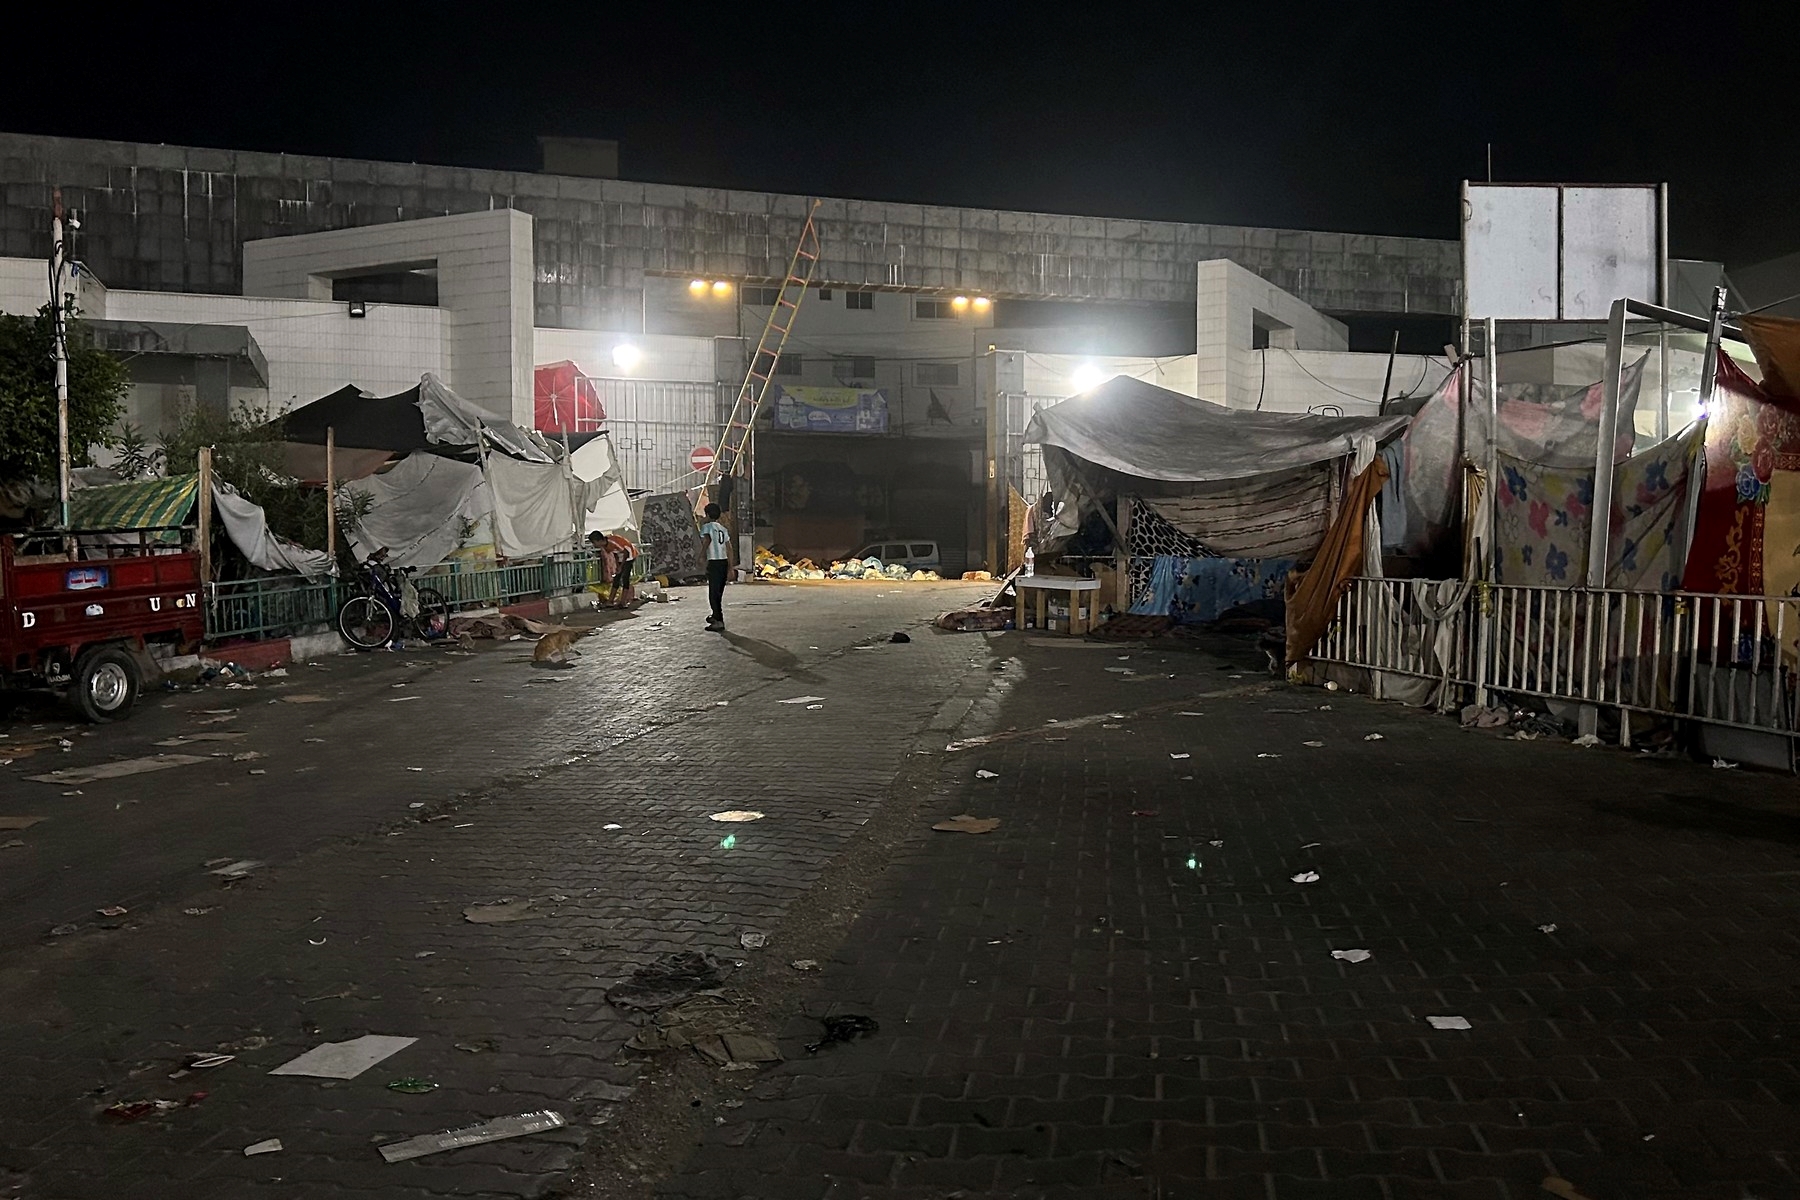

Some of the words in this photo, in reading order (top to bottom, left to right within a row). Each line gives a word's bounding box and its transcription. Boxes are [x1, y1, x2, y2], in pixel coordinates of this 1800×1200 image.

[715, 530, 725, 544] 0
[22, 612, 36, 628] D
[149, 597, 161, 611] U
[185, 593, 197, 608] N
